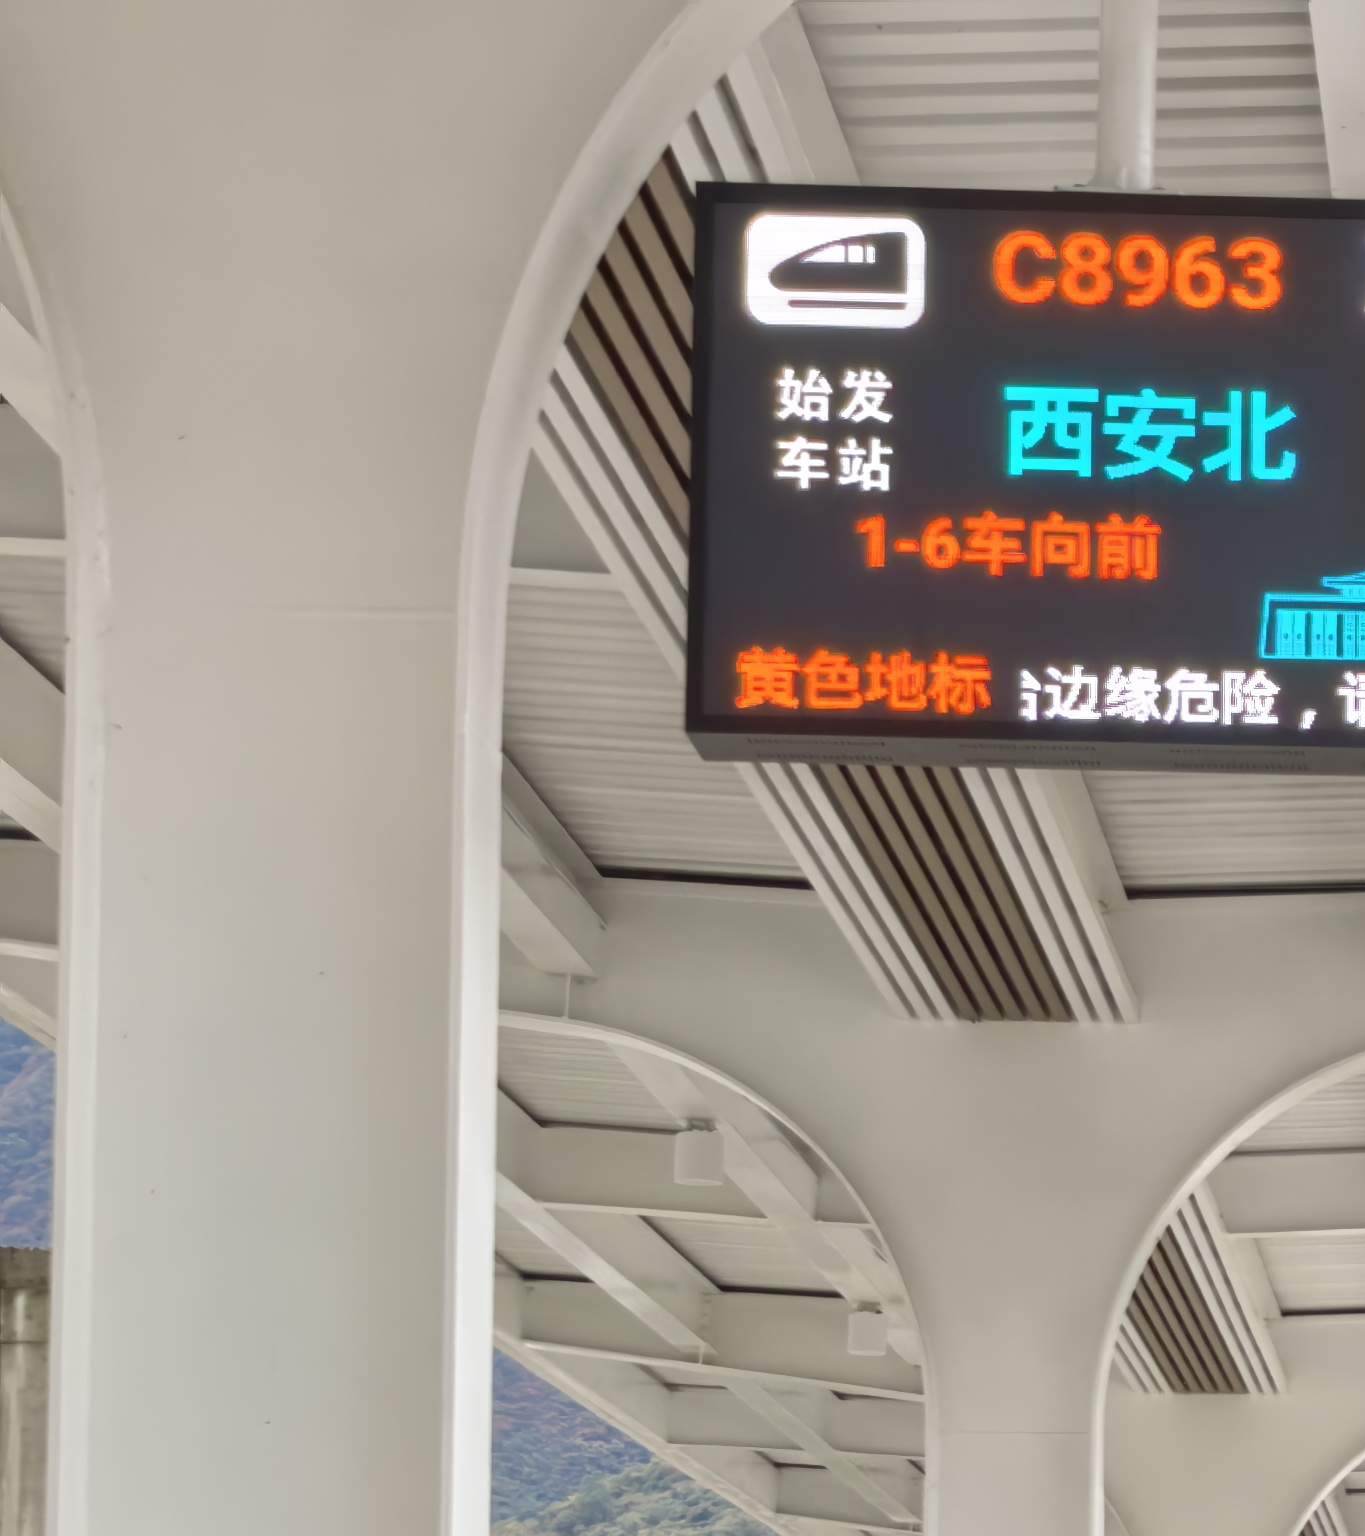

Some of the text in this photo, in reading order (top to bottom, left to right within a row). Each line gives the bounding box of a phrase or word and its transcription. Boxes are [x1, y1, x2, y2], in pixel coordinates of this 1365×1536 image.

[992, 230, 1283, 311] C8963
[775, 367, 893, 423] 始发
[774, 435, 893, 491] 车站
[1004, 386, 1296, 482] 西安北
[856, 510, 1162, 580] 1-6车向前
[735, 646, 992, 715] 黄色地标
